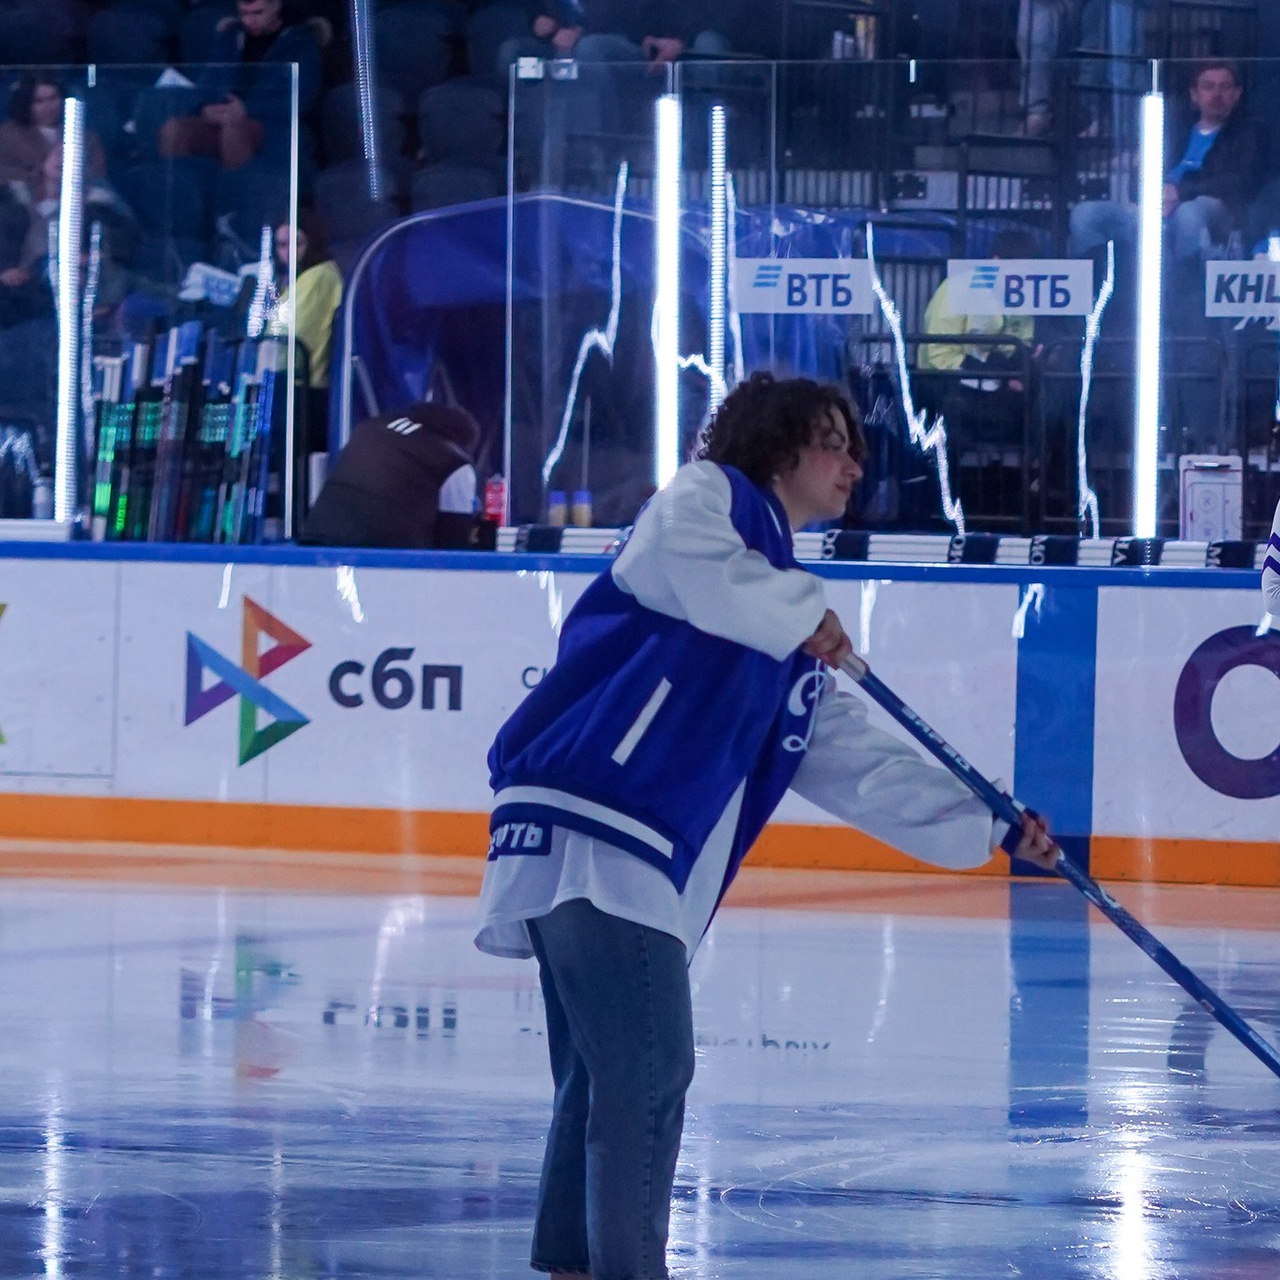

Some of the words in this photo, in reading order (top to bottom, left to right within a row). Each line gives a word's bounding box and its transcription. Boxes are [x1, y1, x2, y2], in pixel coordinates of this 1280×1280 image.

[787, 273, 853, 308] ВТБ
[1004, 274, 1071, 309] ВТБ
[328, 647, 463, 710] сбп
